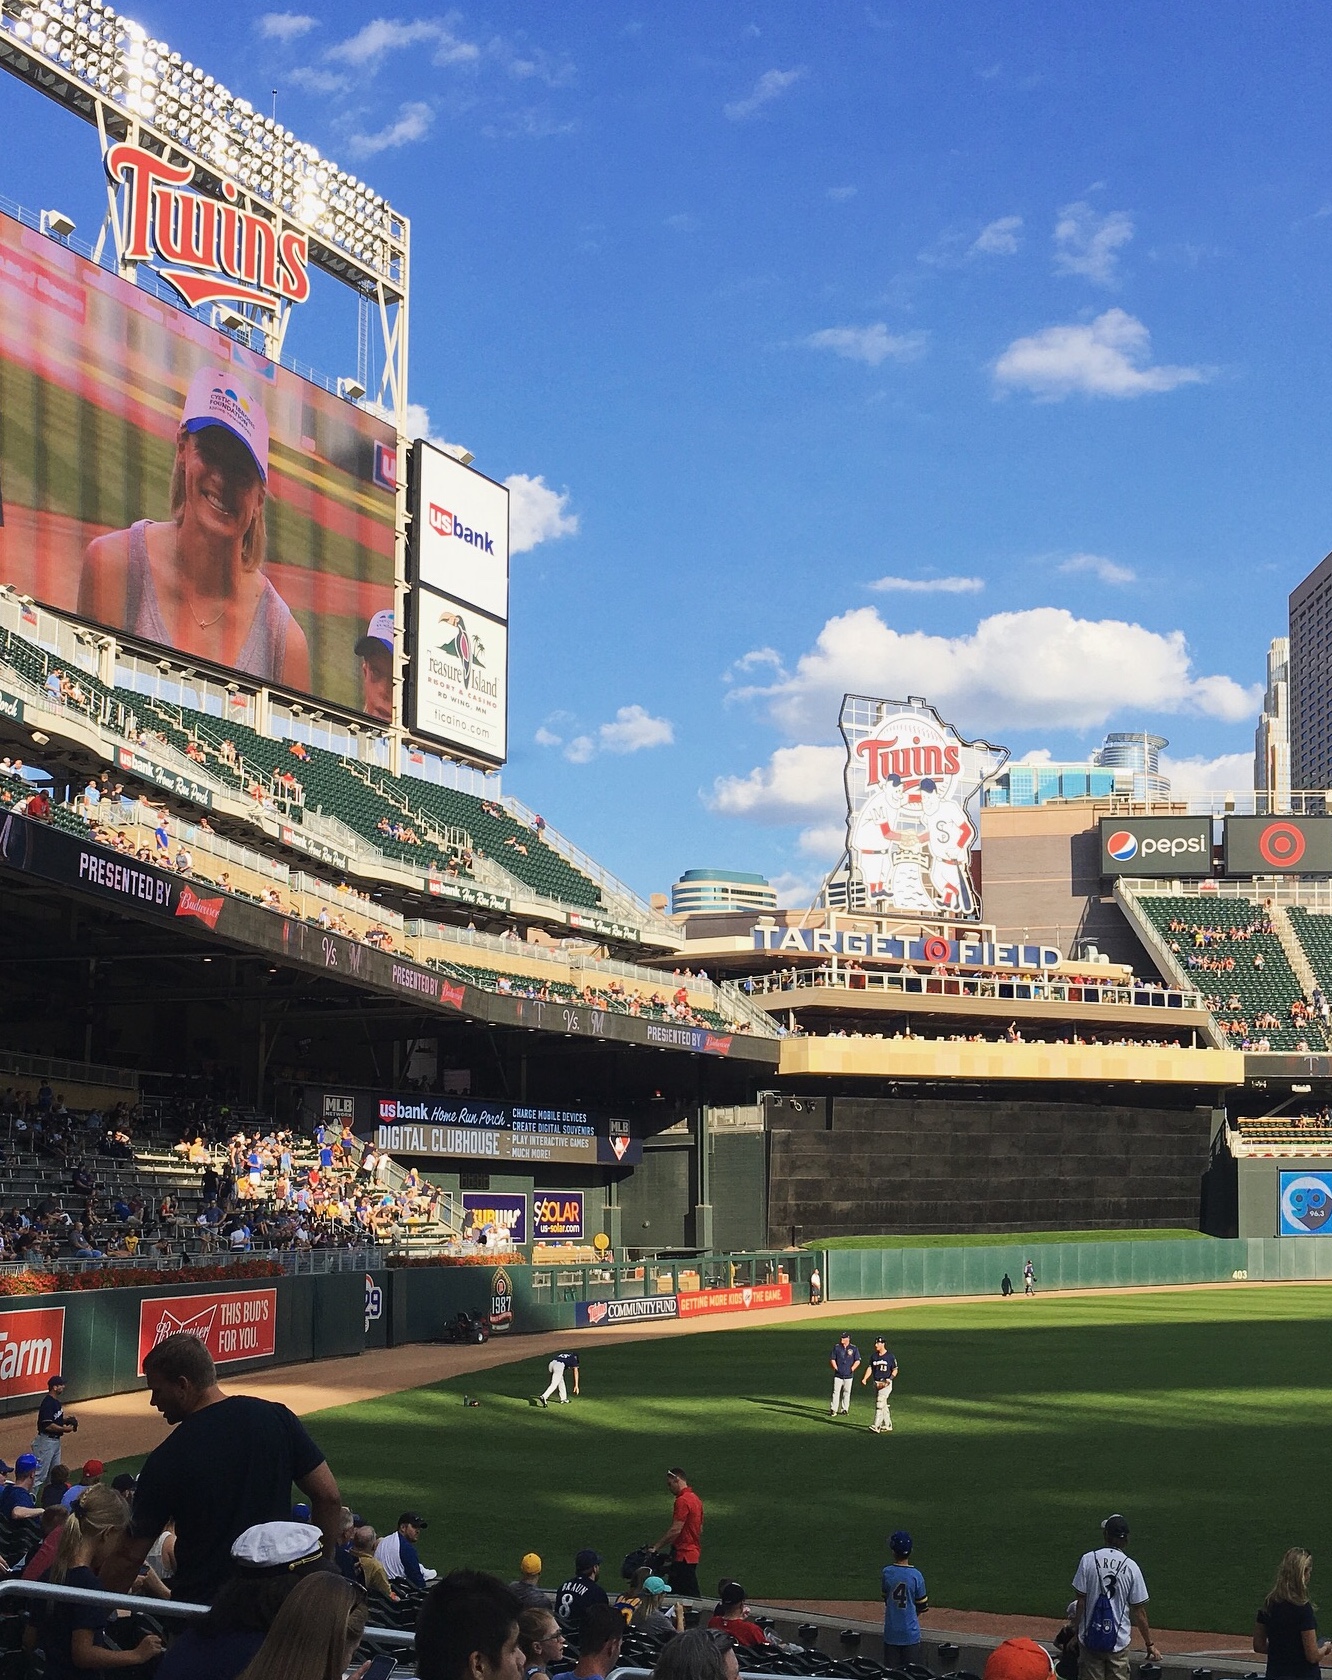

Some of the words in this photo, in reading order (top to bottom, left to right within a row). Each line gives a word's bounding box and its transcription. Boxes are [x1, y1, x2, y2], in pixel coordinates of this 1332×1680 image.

[107, 143, 310, 304] Twins
[209, 400, 249, 429] FOUNDATION
[429, 503, 494, 556] usbank
[471, 668, 498, 698] Island
[467, 692, 498, 709] CASINO
[475, 706, 487, 715] MN
[119, 748, 154, 779] usbank
[154, 766, 175, 790] Home
[175, 777, 189, 796] Run
[857, 736, 960, 786] Twins
[1141, 834, 1206, 857] pepsi
[79, 852, 153, 902] PRESENTED
[156, 880, 172, 907] BY
[429, 881, 461, 898] usbank
[180, 892, 220, 920] Budweiser
[322, 937, 338, 966] Vs.
[754, 925, 919, 960] TARGET
[960, 940, 1063, 970] FIELD
[392, 965, 429, 994] PRESENTED
[429, 976, 439, 996] BY
[563, 1009, 580, 1031] Vs.
[692, 1032, 701, 1048] BY
[326, 1098, 352, 1112] MLB
[379, 1101, 430, 1120] usbank
[431, 1107, 457, 1122] Home
[458, 1107, 477, 1124] Run
[479, 1110, 505, 1126] Porch
[512, 1107, 537, 1120] CHARGE
[538, 1109, 561, 1121] MOBILE
[562, 1111, 587, 1123] DEVICES
[512, 1121, 537, 1133] CREATE
[538, 1123, 561, 1134] DIGITAL
[562, 1124, 595, 1136] SOUVENIRS
[610, 1120, 629, 1132] MLB
[378, 1125, 427, 1151] DIGITAL
[432, 1128, 500, 1155] CLUBHOUSE
[512, 1134, 529, 1146] PLAY
[530, 1134, 569, 1147] INTERACTIVE
[569, 1136, 589, 1148] GAMES
[511, 1147, 531, 1159] MUCH
[531, 1148, 551, 1160] MORE!
[1291, 1187, 1326, 1218] go
[1309, 1210, 1325, 1218] 96.3
[540, 1224, 580, 1233] us-solar.com
[1232, 1270, 1247, 1280] 403
[491, 1296, 511, 1314] 1987
[588, 1302, 607, 1323] Twins
[608, 1303, 656, 1318] COMMUNITY
[656, 1300, 676, 1315] FUND
[681, 1295, 708, 1311] GETTING
[709, 1294, 728, 1307] MORE
[729, 1293, 742, 1305] KIDS
[753, 1291, 764, 1303] THE
[764, 1289, 783, 1302] GAME.
[221, 1301, 241, 1326] THIS
[243, 1299, 269, 1323] BUD'S
[219, 1330, 237, 1353] FOR
[239, 1326, 259, 1350] YOU.
[1096, 1557, 1128, 1575] ARCIA
[562, 1582, 588, 1596] BRAUN
[892, 1582, 907, 1609] 4
[1103, 1575, 1117, 1600] 3
[559, 1593, 573, 1617] 8
